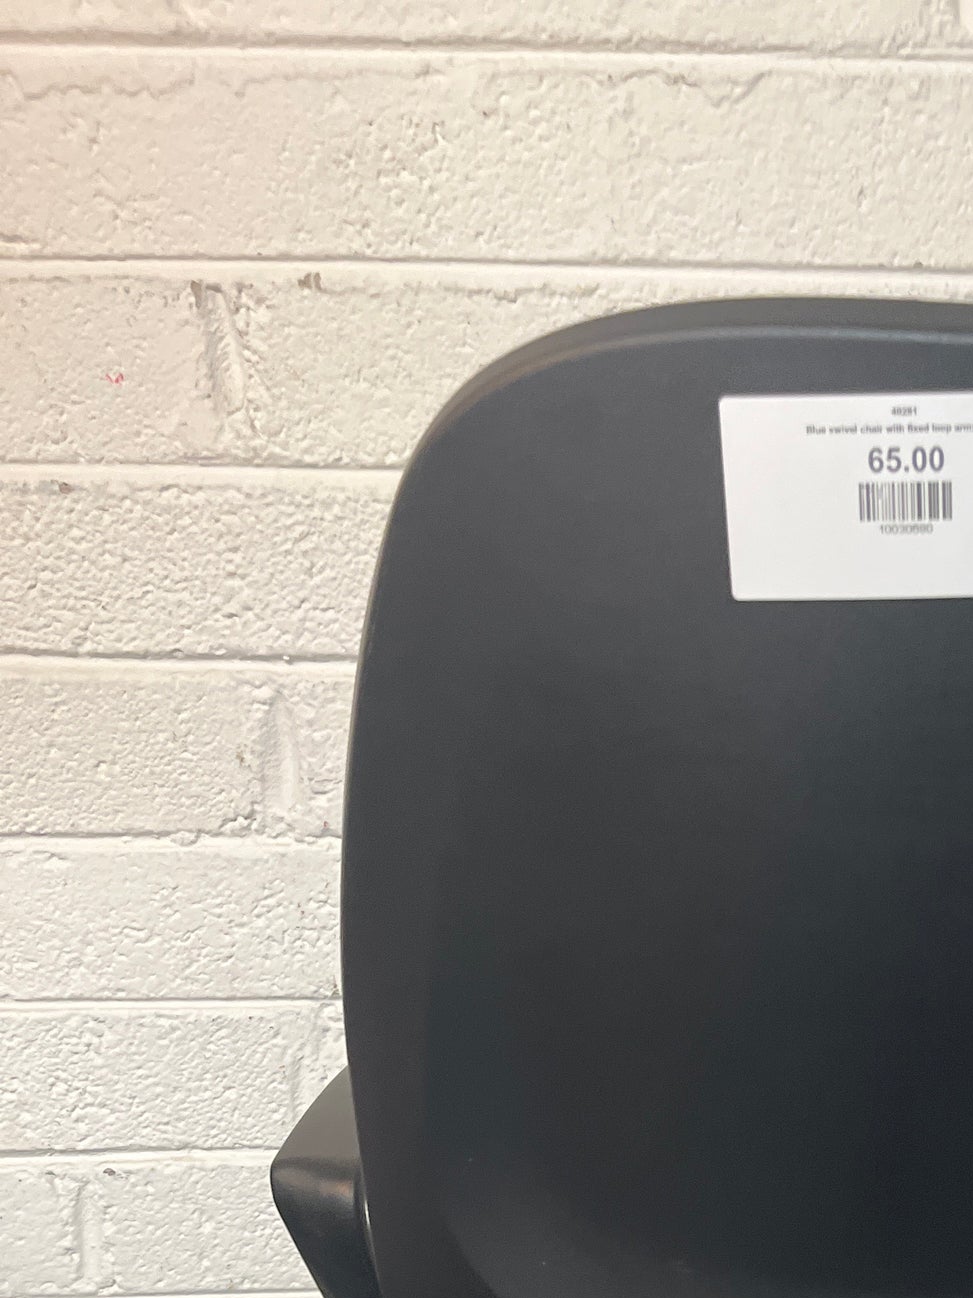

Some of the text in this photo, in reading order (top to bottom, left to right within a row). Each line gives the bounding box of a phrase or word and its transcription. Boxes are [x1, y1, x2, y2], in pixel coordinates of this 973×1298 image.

[806, 425, 826, 435] Blue
[829, 425, 858, 435] swivel
[860, 424, 883, 434] chair
[886, 424, 905, 433] with
[907, 423, 929, 433] fixed
[932, 423, 951, 435] loop
[868, 446, 945, 473] 65.00
